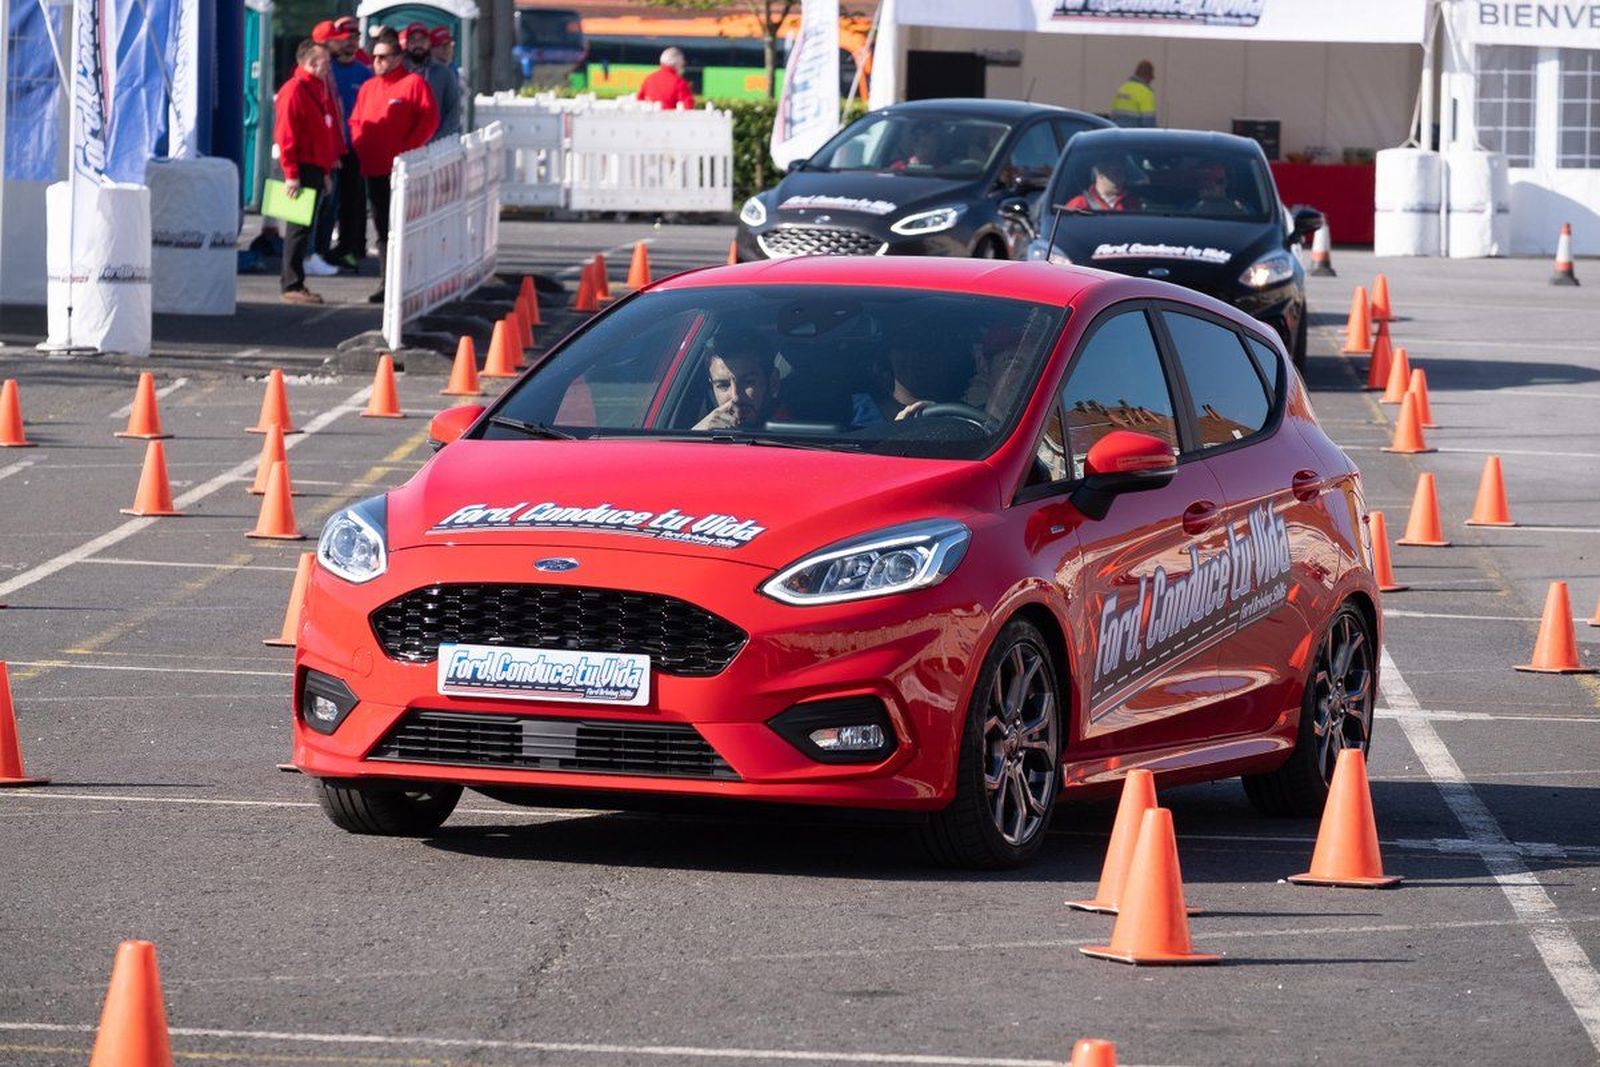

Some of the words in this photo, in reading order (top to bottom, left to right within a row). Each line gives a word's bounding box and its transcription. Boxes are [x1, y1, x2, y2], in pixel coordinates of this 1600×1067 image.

[516, 501, 653, 526] Conduce
[649, 508, 696, 531] tu
[690, 513, 768, 541] Vida
[1146, 543, 1231, 650] Conduce
[1227, 520, 1253, 602] tu
[1248, 500, 1291, 588] Vida
[447, 649, 495, 681] Ford,
[494, 652, 576, 686] Conduce
[574, 656, 601, 686] tu
[599, 657, 645, 689] Vida
